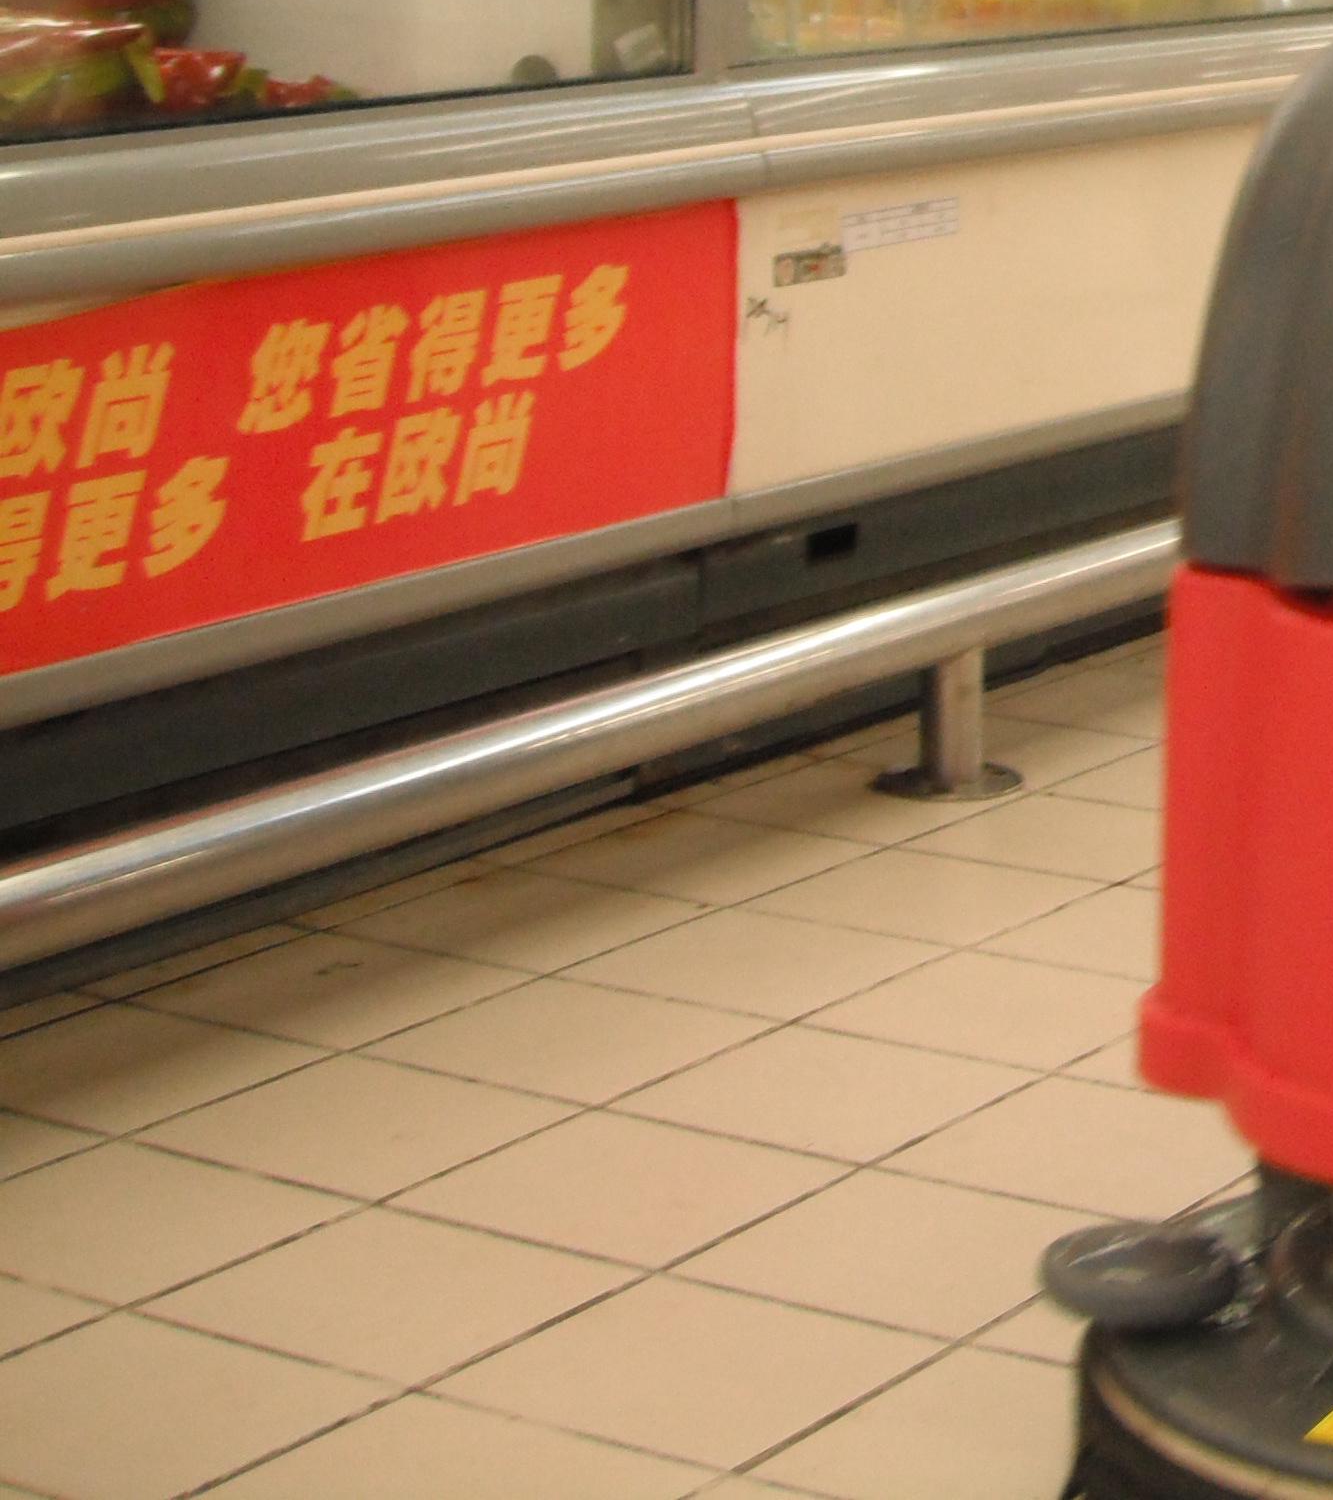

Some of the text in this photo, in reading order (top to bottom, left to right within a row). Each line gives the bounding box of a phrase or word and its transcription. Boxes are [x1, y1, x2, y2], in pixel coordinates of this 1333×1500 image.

[236, 265, 630, 436] 您省得更多
[301, 392, 535, 543] 在欧尚
